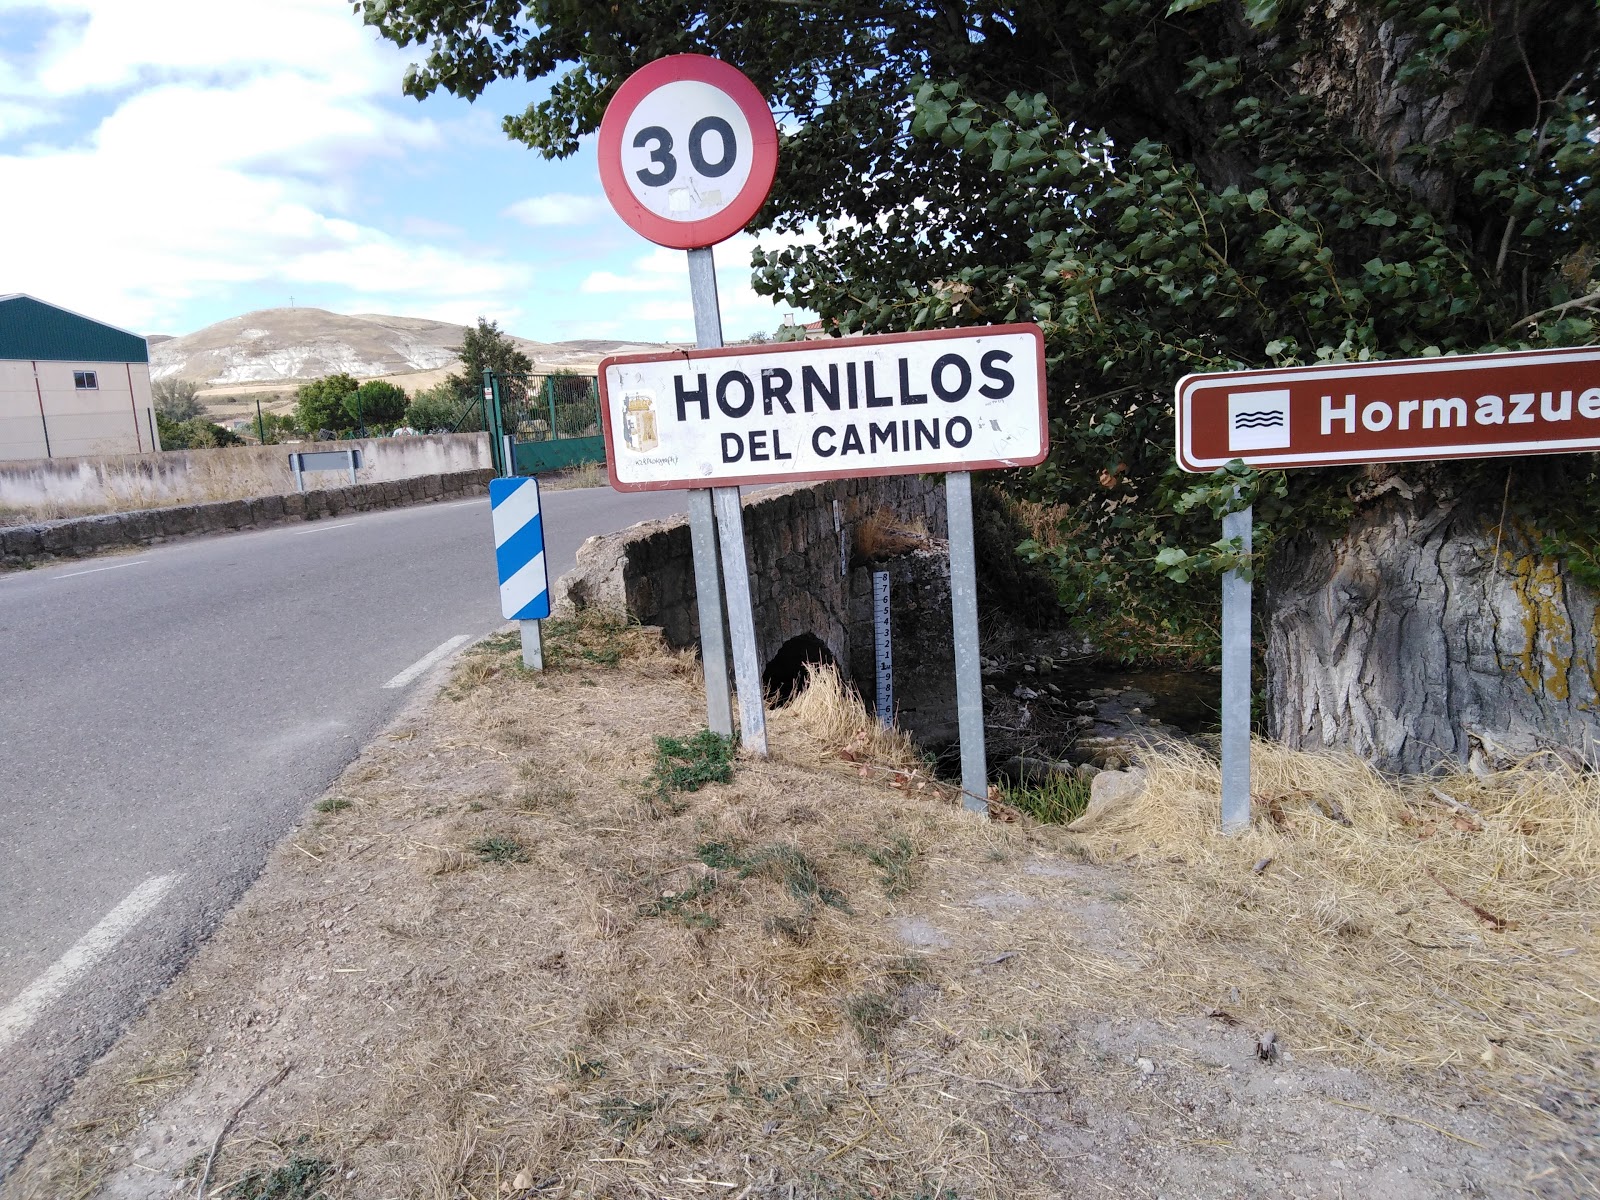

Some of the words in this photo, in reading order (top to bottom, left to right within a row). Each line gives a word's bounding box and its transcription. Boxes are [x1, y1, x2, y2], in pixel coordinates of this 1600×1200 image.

[633, 116, 737, 187] 30
[674, 350, 1015, 421] HORNILLOS
[720, 429, 792, 463] DEL
[812, 415, 973, 457] CAMINO
[882, 573, 888, 581] 8
